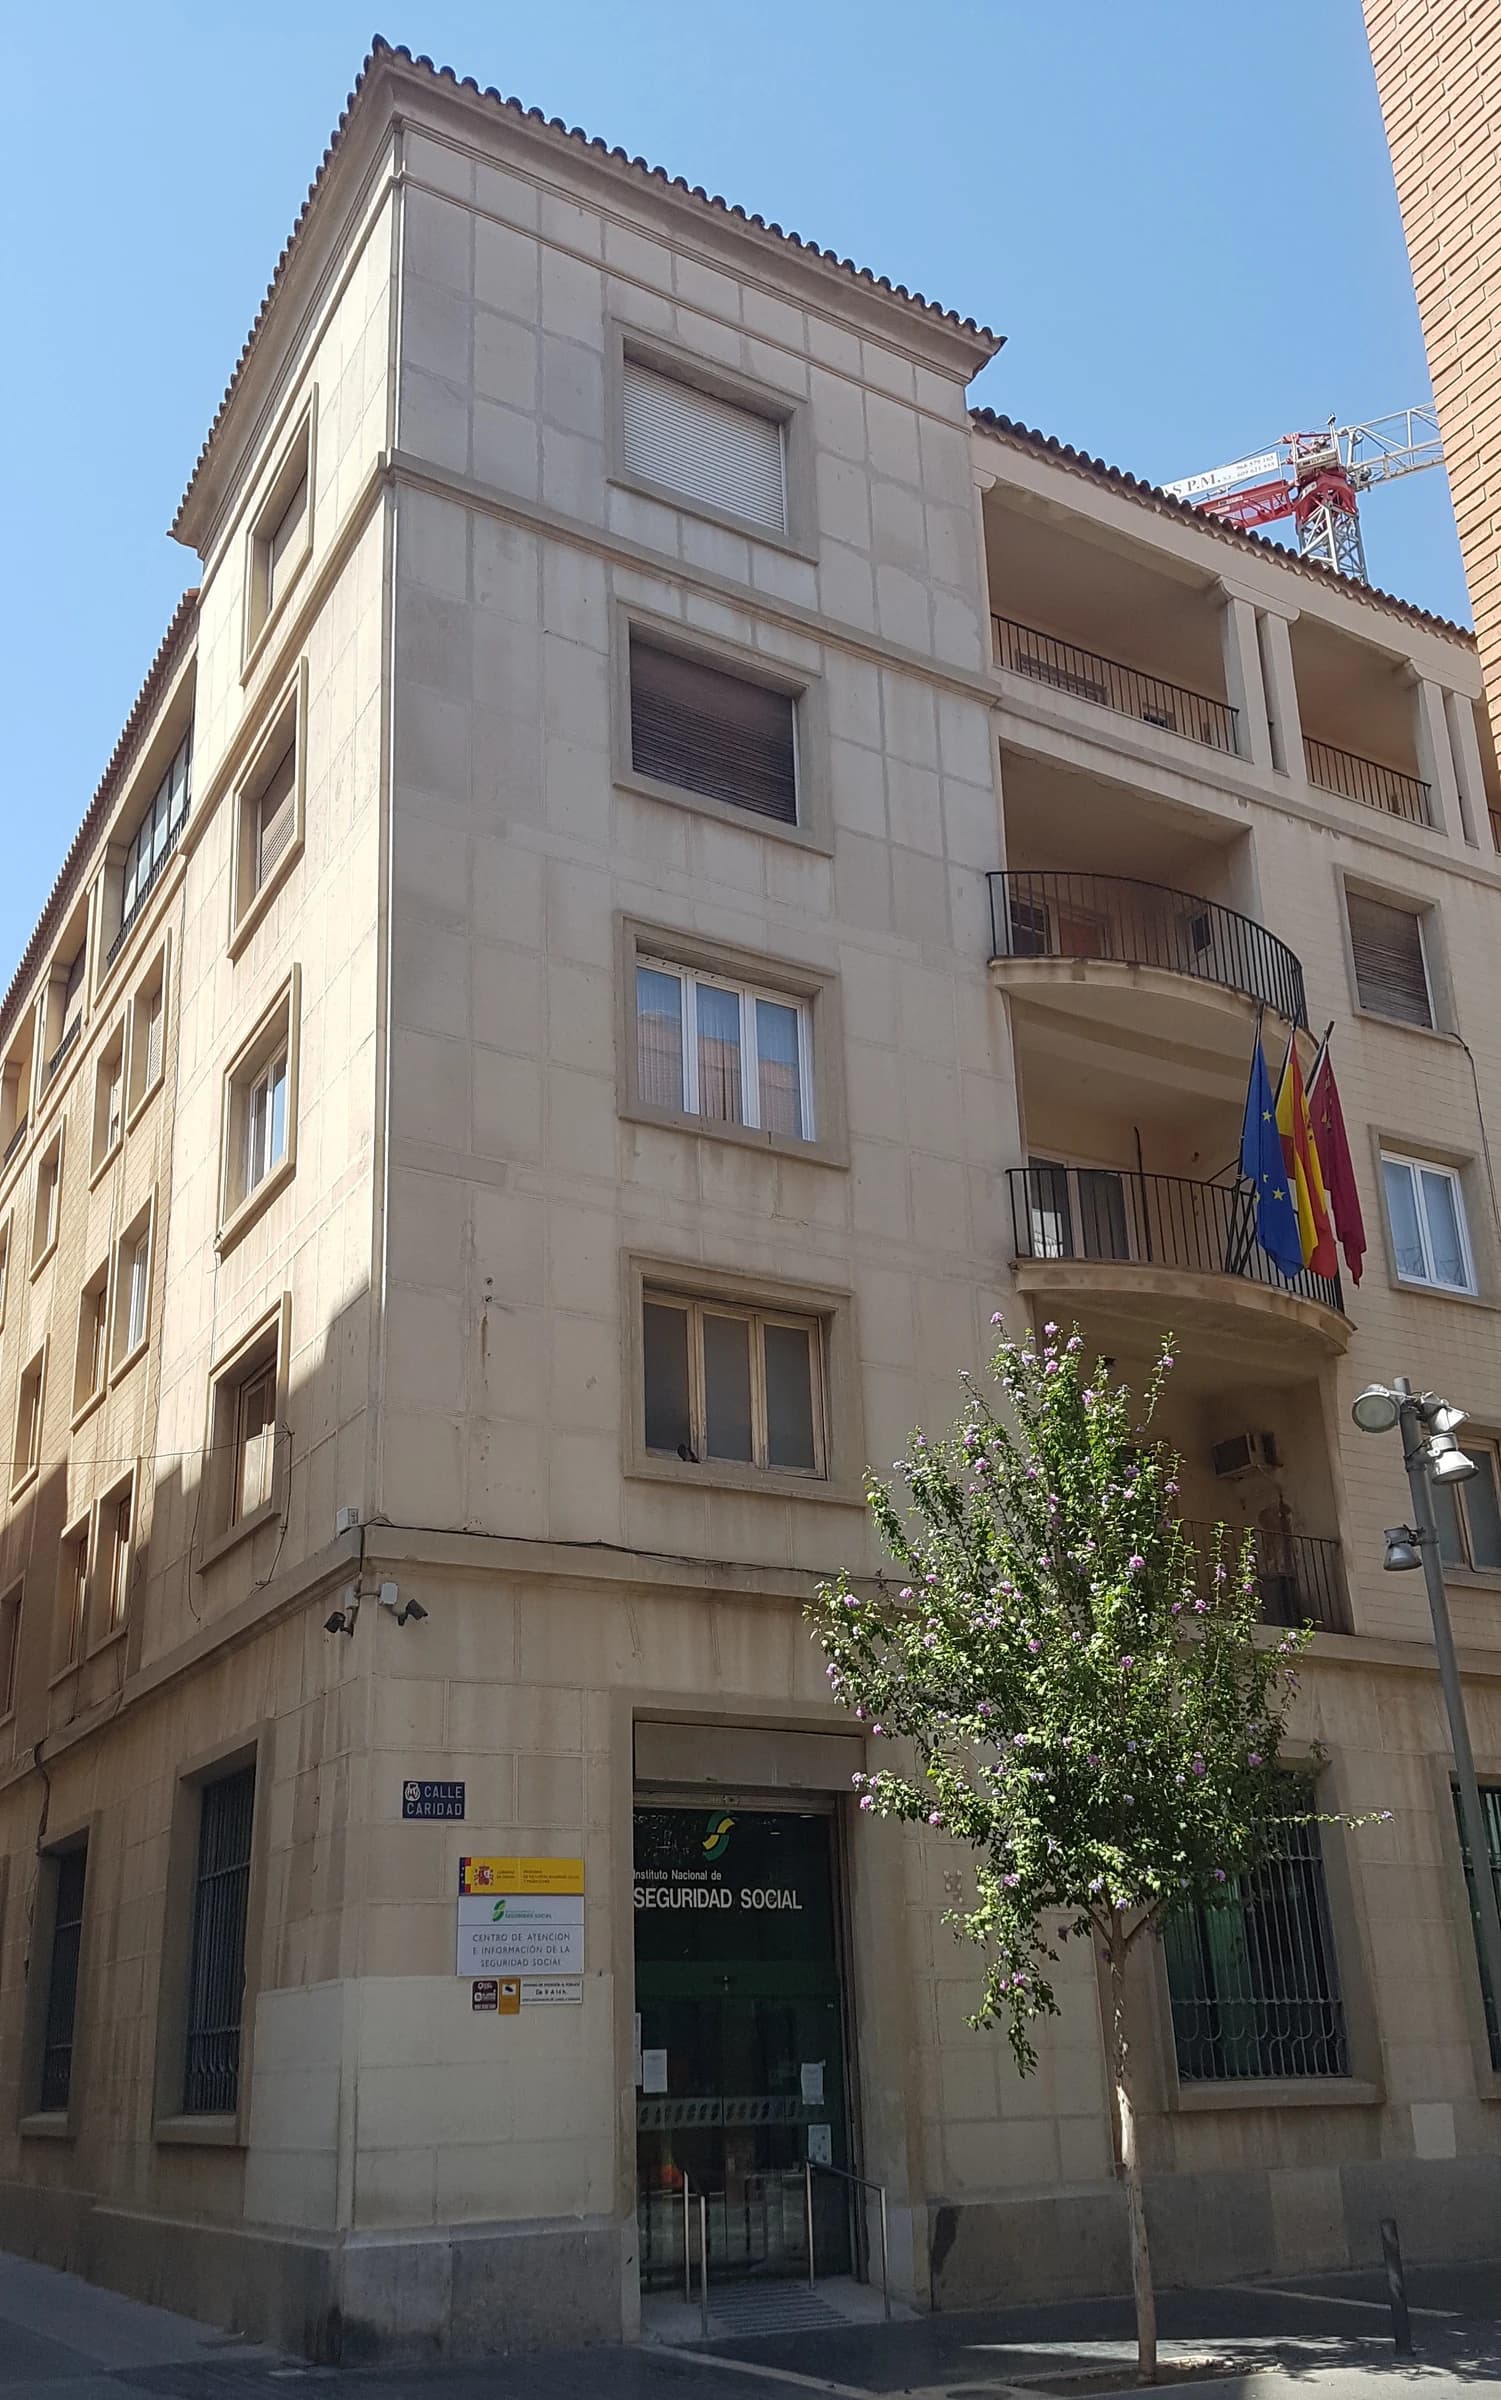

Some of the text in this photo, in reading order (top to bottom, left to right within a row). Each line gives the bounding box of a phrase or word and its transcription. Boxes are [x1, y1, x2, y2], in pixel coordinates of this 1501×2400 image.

[424, 1784, 463, 1799] CALLE
[407, 1802, 462, 1816] CARIDAD
[633, 1869, 722, 1881] Instituto Nacional de
[633, 1887, 803, 1909] SEGURIDAD SOCIAL
[472, 1933, 508, 1942] CENTRO
[511, 1933, 522, 1941] DE
[481, 1944, 543, 1955] INFORMACIÓN
[546, 1945, 556, 1953] DE
[560, 1945, 570, 1953] LA
[480, 1958, 561, 1968] SEGURIDAD SOCIAL
